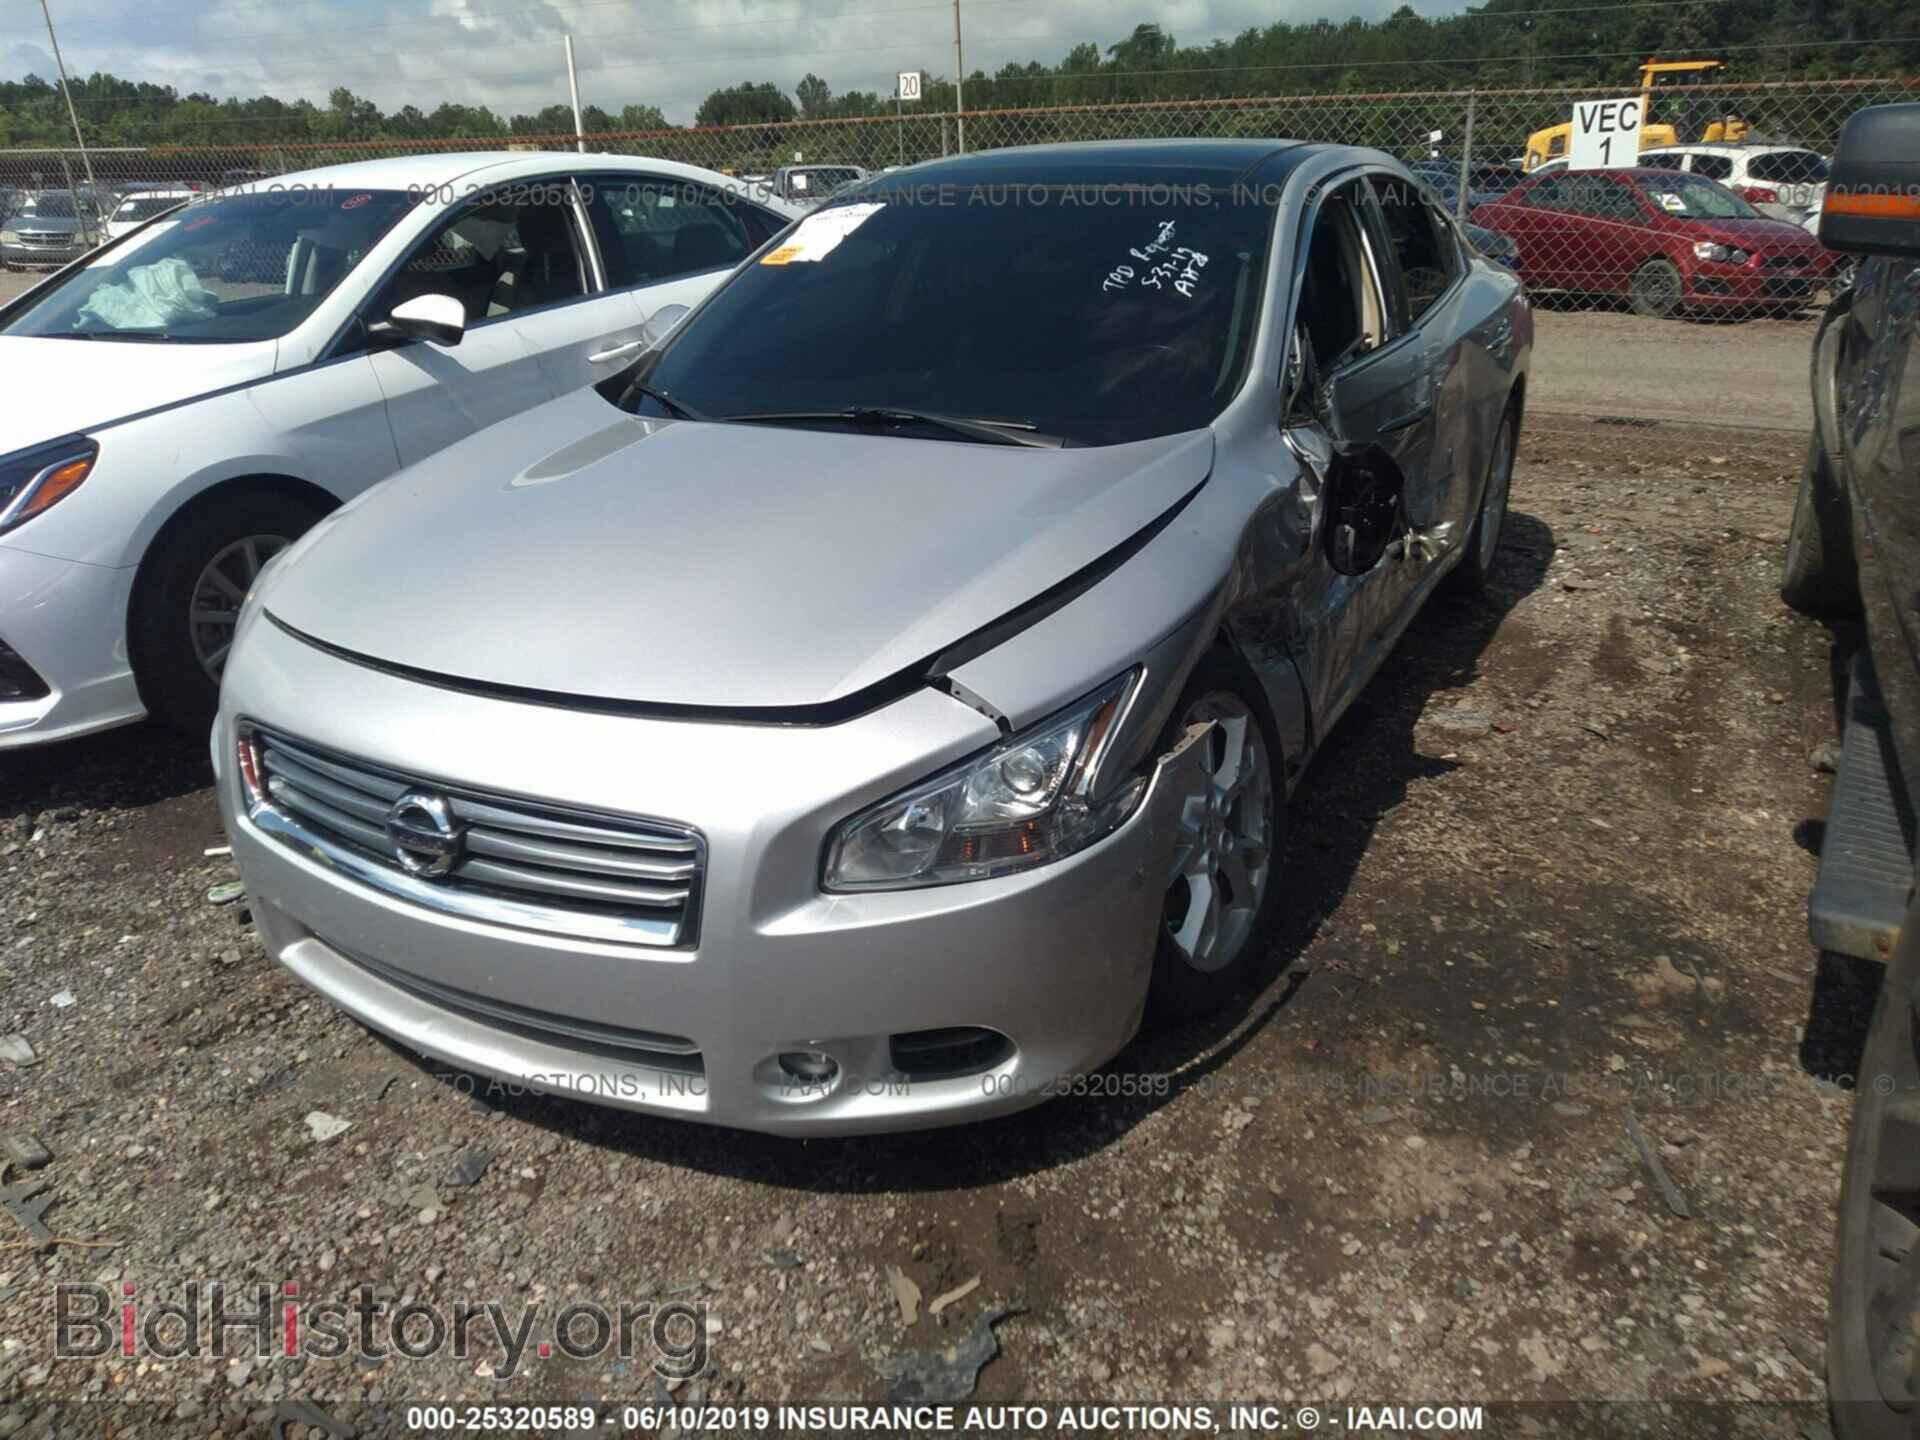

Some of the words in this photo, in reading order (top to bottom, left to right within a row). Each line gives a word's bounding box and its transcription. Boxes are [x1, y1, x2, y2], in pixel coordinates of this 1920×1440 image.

[902, 75, 919, 97] 20
[1578, 101, 1639, 134] VEC
[1599, 136, 1612, 166] 1
[1102, 264, 1135, 292] TPD
